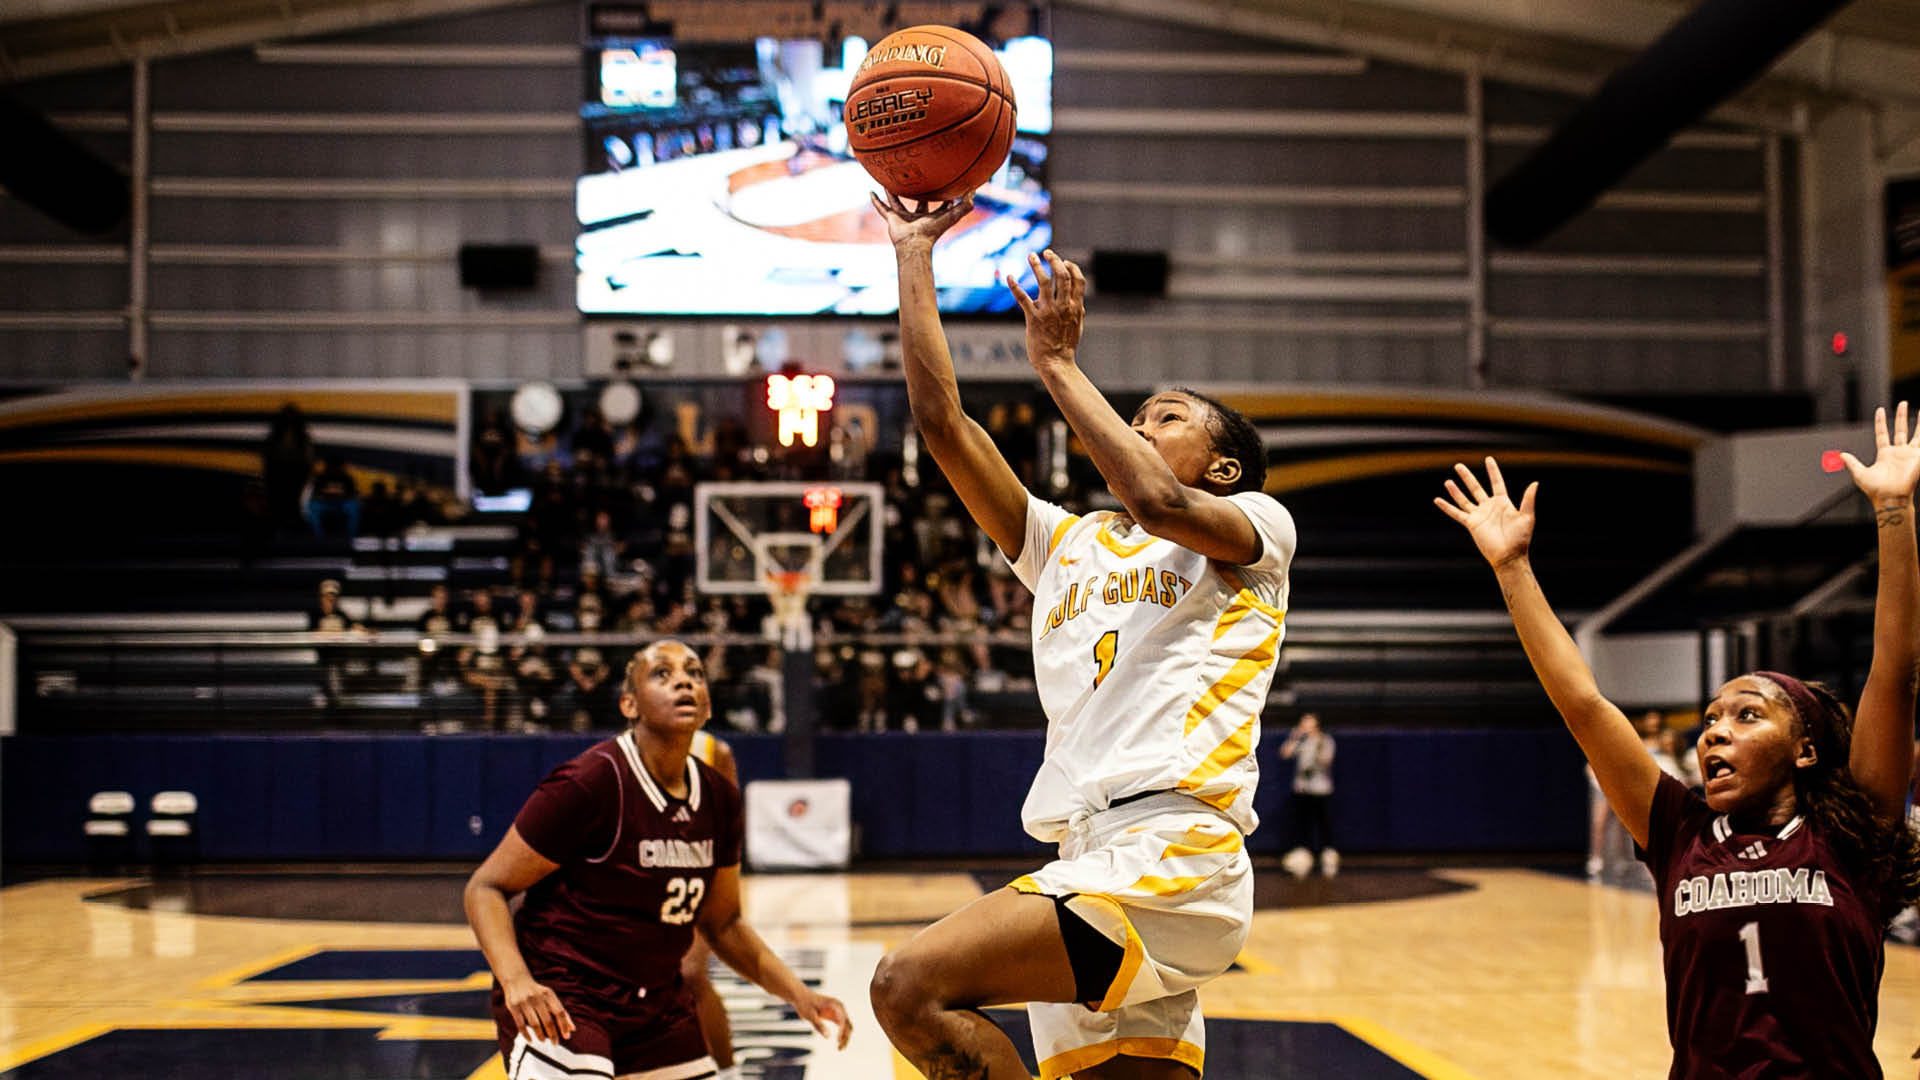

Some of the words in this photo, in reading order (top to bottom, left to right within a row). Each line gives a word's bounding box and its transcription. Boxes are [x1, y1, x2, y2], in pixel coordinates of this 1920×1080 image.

[849, 88, 934, 122] LEGACY
[1093, 630, 1119, 691] 1
[660, 877, 705, 925] 23
[1674, 868, 1834, 917] COAHOMA
[1738, 921, 1769, 995] 1
